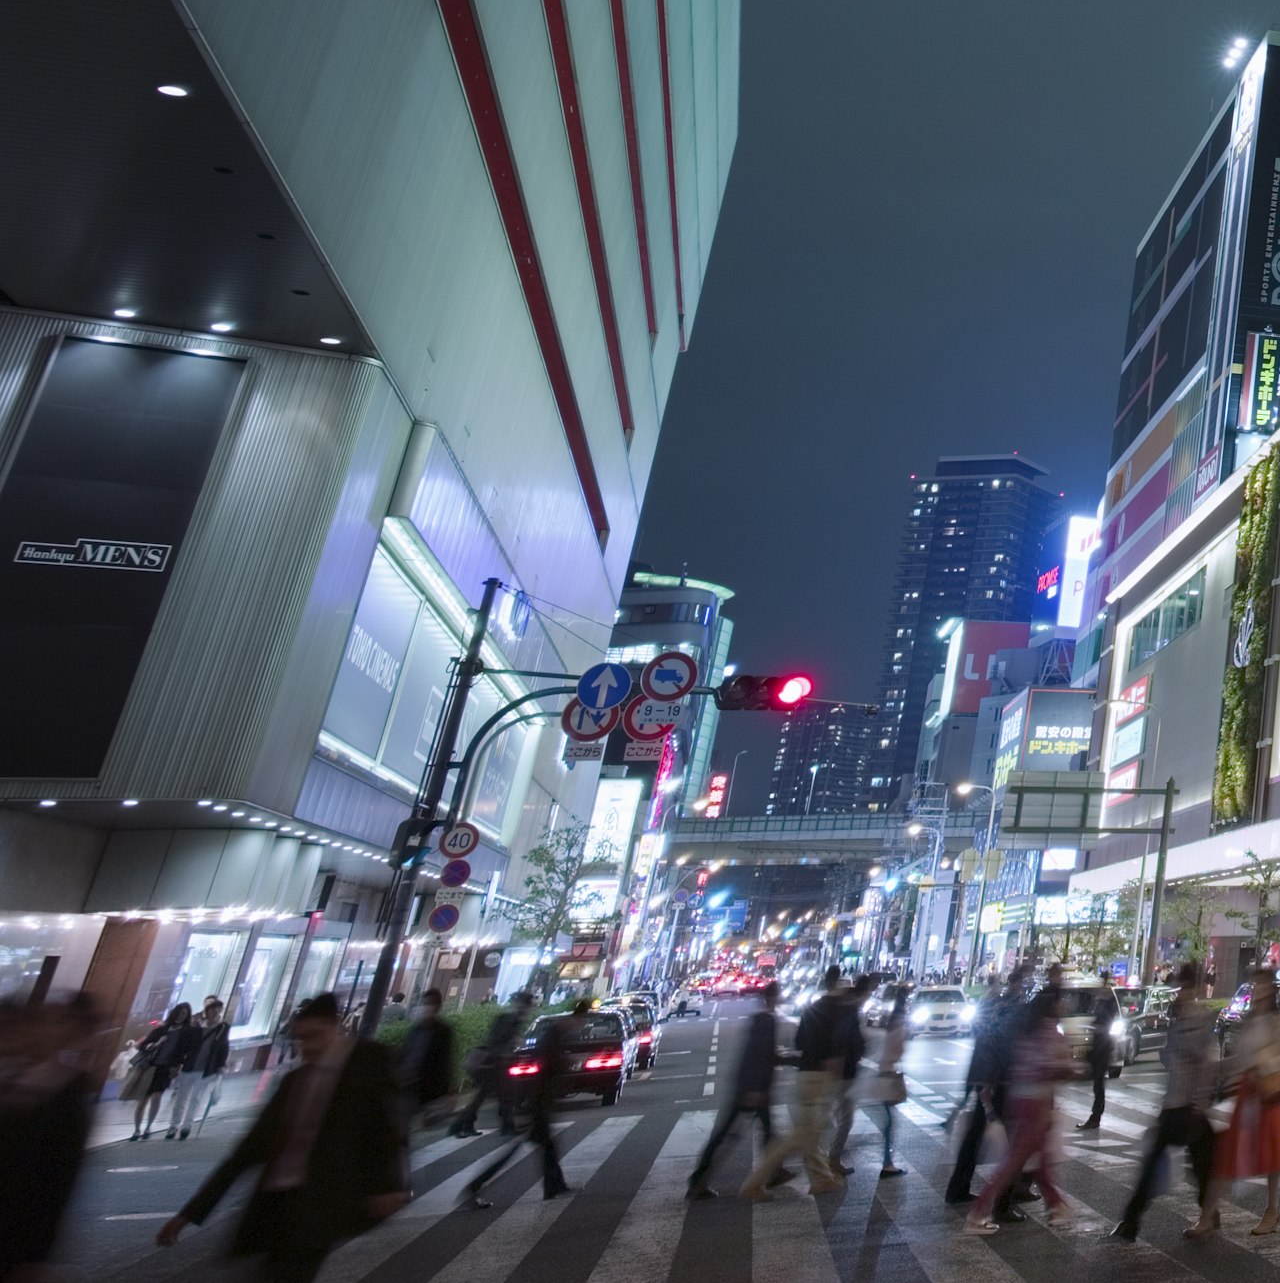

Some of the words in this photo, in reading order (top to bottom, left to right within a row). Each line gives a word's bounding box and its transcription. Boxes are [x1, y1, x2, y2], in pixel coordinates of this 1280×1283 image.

[1260, 262, 1272, 303] SPORTS
[23, 547, 76, 563] Hankyu
[347, 624, 373, 671] TOHO
[366, 641, 400, 694] CINEMAS
[565, 747, 601, 758] ここから
[626, 746, 662, 758] ここから
[447, 831, 471, 849] 40
